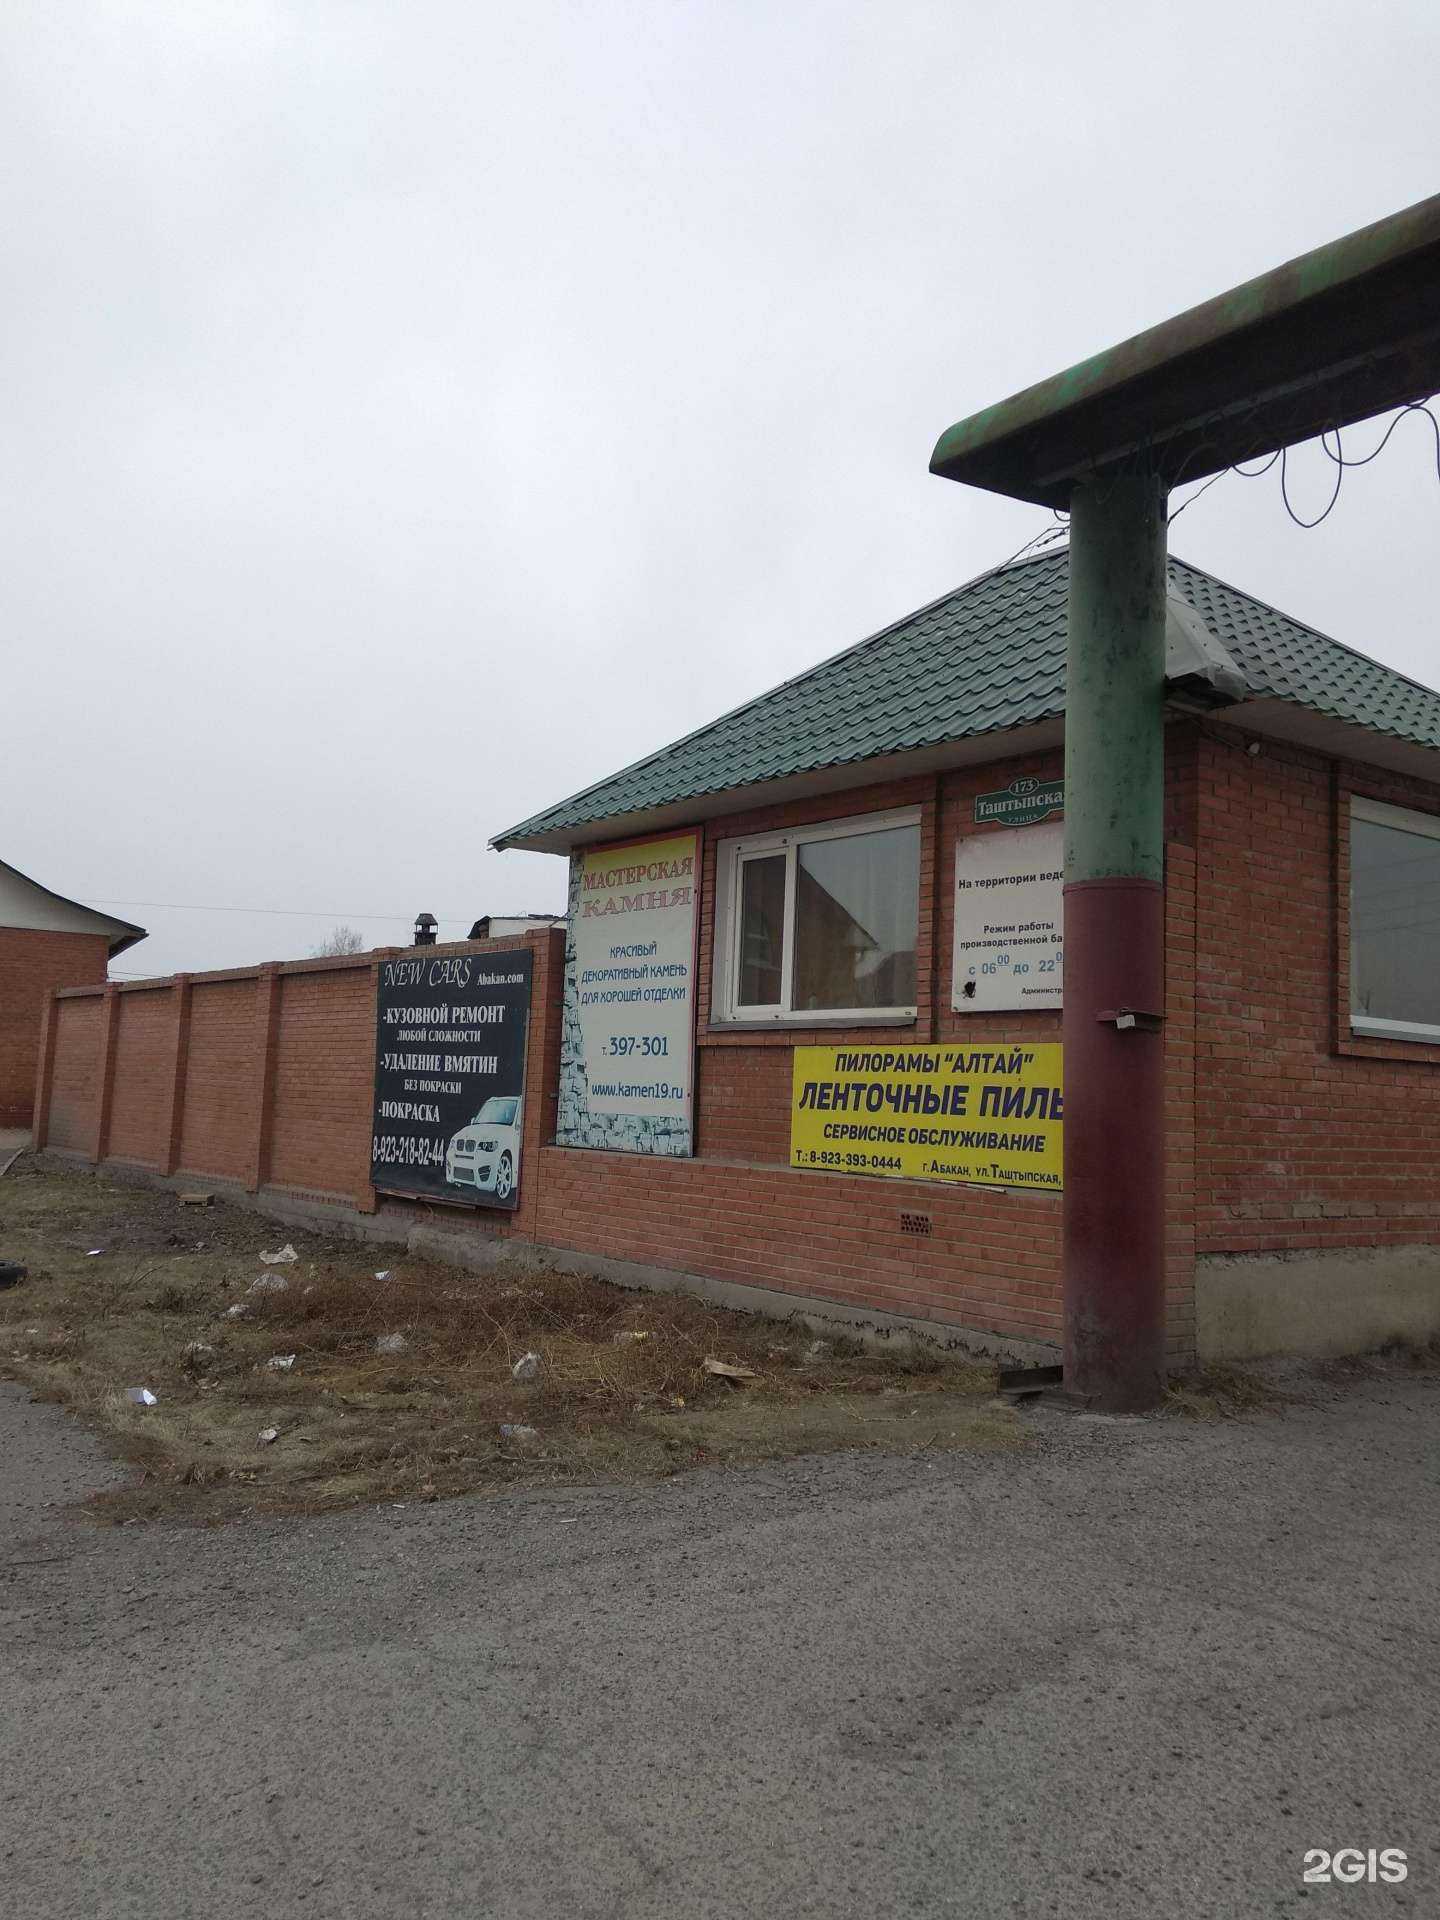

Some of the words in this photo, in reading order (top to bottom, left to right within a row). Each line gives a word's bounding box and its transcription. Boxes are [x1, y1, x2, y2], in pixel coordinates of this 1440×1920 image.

[1015, 780, 1034, 794] 173
[978, 791, 1065, 816] Таштыпска
[582, 857, 694, 891] МАСТЕРСКАЯ
[958, 878, 972, 889] На
[975, 874, 1036, 889] территории
[582, 886, 693, 918] КАМНЯ
[983, 924, 1016, 934] Режим
[1018, 921, 1054, 933] работы
[609, 940, 657, 959] КРАСИВЫЙ
[960, 934, 1048, 951] производственной
[384, 961, 426, 987] NEW
[429, 958, 472, 988] CARS
[477, 973, 524, 986] Abakan.com
[581, 964, 649, 984] ДЕКОРАТИВНЫЙ
[650, 964, 687, 978] КАМЕНЬ
[1013, 963, 1029, 976] до
[581, 992, 599, 1006] ДЛЯ
[600, 987, 643, 1004] ХОРОШЕЙ
[644, 988, 686, 1004] ОТДЕЛКИ
[451, 1005, 506, 1024] РЕМОНТ
[396, 1028, 427, 1042] ЛЮБОЙ
[428, 1030, 481, 1043] СЛОЖНОСТИ
[609, 1036, 668, 1057] 397-301
[443, 1056, 498, 1074] ВМЯТИН
[835, 1053, 940, 1073] ПИЛОРАМЫ
[944, 1047, 1034, 1075] "АЛТАЙ"
[404, 1079, 418, 1091] БЕЗ
[419, 1080, 462, 1094] ПОКРАСКИ
[591, 1080, 683, 1100] www.kamen19.ru
[799, 1082, 970, 1116] ЛЕНТОЧНЫЕ
[823, 1123, 905, 1144] СЕРВИСНОЕ
[908, 1127, 1046, 1153] ОБСЛУЖИВАНИЕ
[372, 1135, 445, 1167] 8-923-218-82-44
[809, 1150, 902, 1170] 8-923-393-0444
